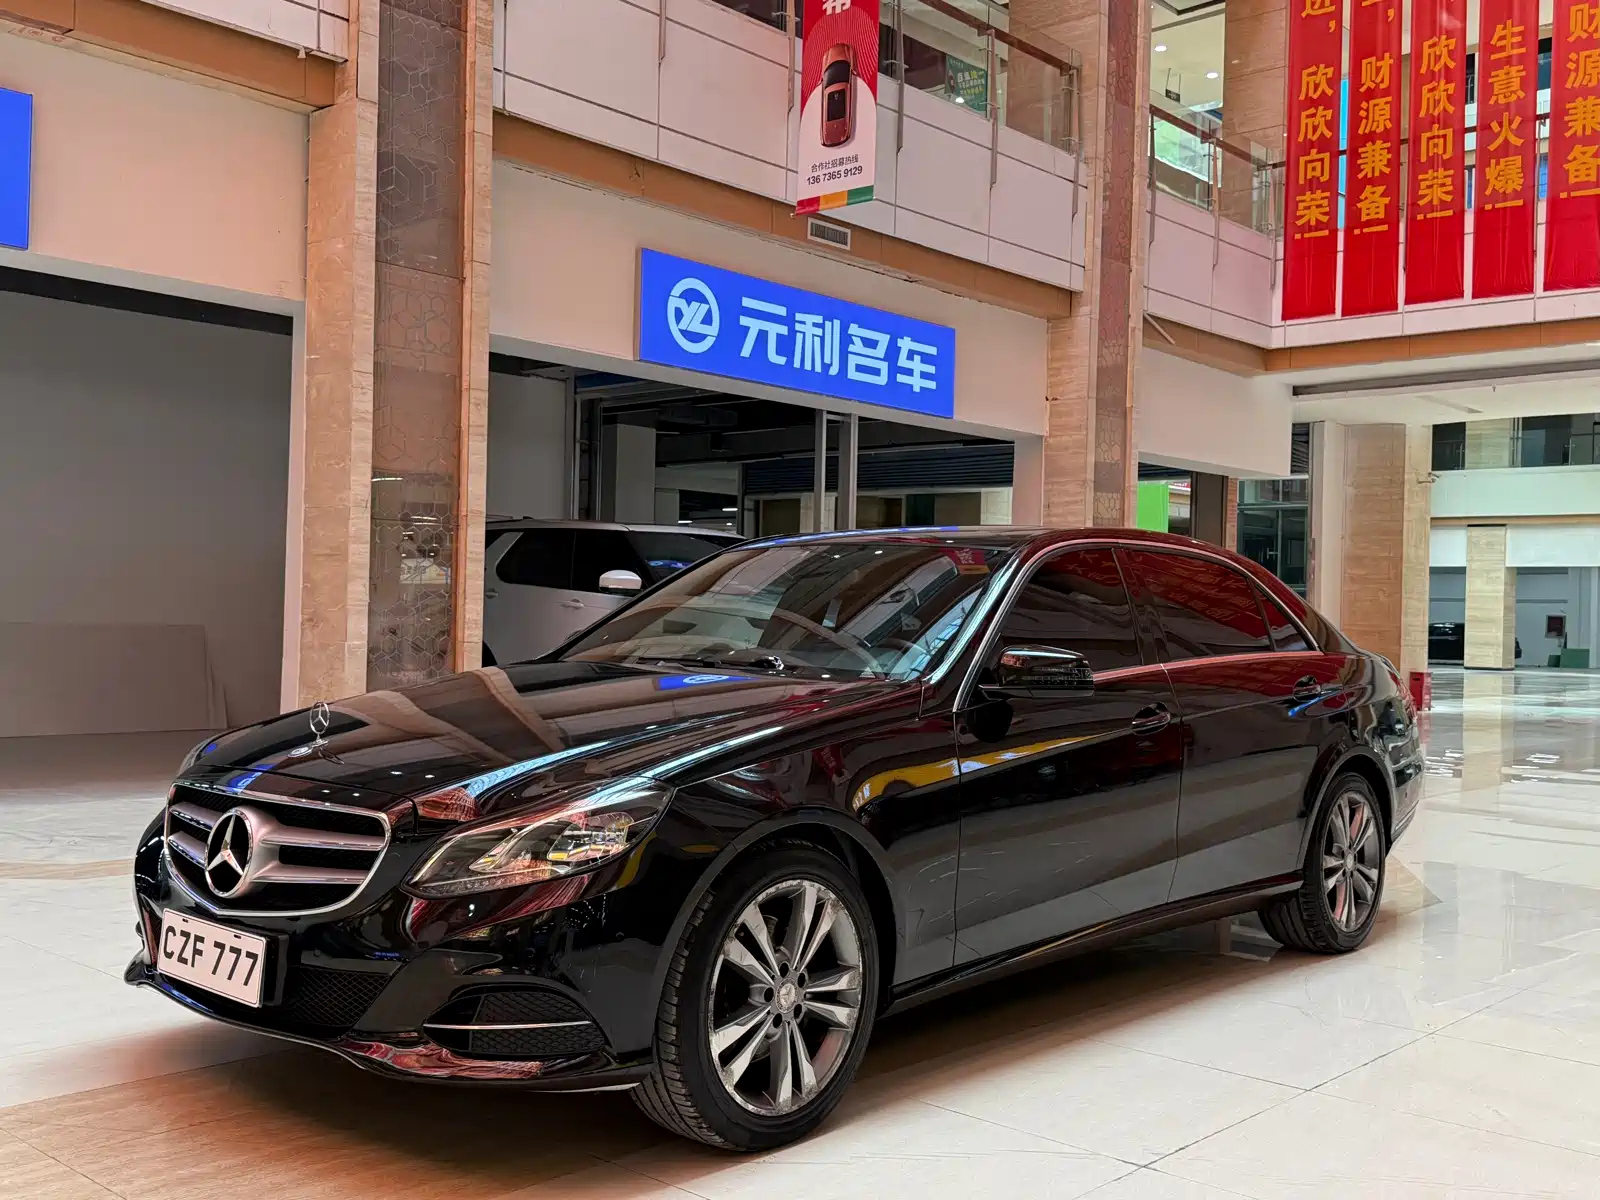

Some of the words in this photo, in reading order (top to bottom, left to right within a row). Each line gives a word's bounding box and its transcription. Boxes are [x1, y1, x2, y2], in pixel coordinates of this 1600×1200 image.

[811, 154, 859, 173] 合作社招募热线
[1354, 0, 1395, 235] ，财源兼备！
[1416, 34, 1457, 220] 欣欣向荣！
[1485, 19, 1527, 211] 生意火爆！
[807, 174, 821, 185] 136
[822, 170, 842, 182] 7365
[843, 165, 863, 178] 9129
[739, 296, 938, 393] 元利名车
[163, 925, 205, 968] CZF
[211, 941, 259, 987] 777
